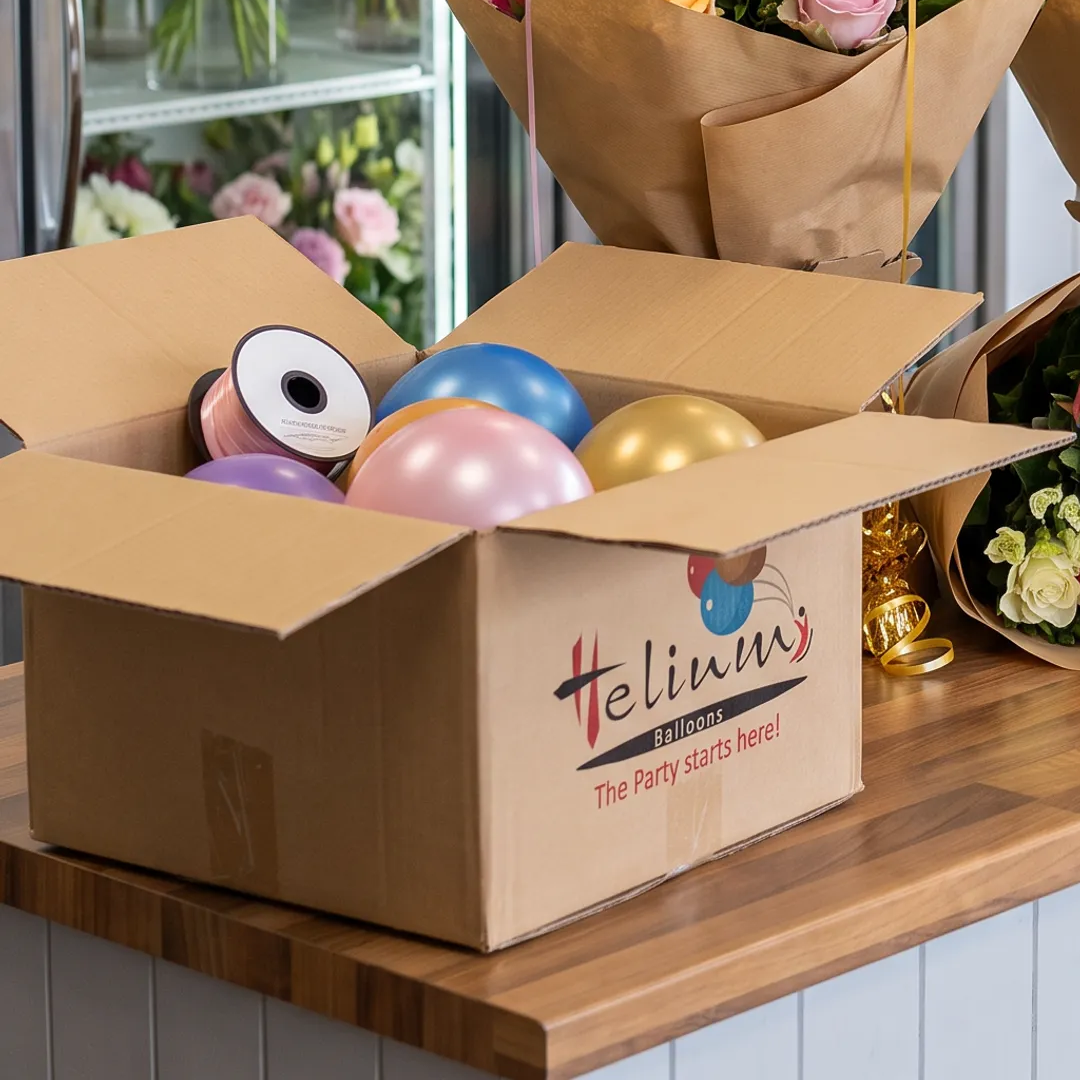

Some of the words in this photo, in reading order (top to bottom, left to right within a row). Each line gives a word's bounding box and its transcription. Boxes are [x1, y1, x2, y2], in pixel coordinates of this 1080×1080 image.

[553, 625, 795, 751] Helium
[653, 707, 724, 748] Balloons
[594, 780, 628, 809] The
[633, 759, 680, 795] Party
[683, 738, 732, 774] starts
[737, 712, 781, 753] here!
